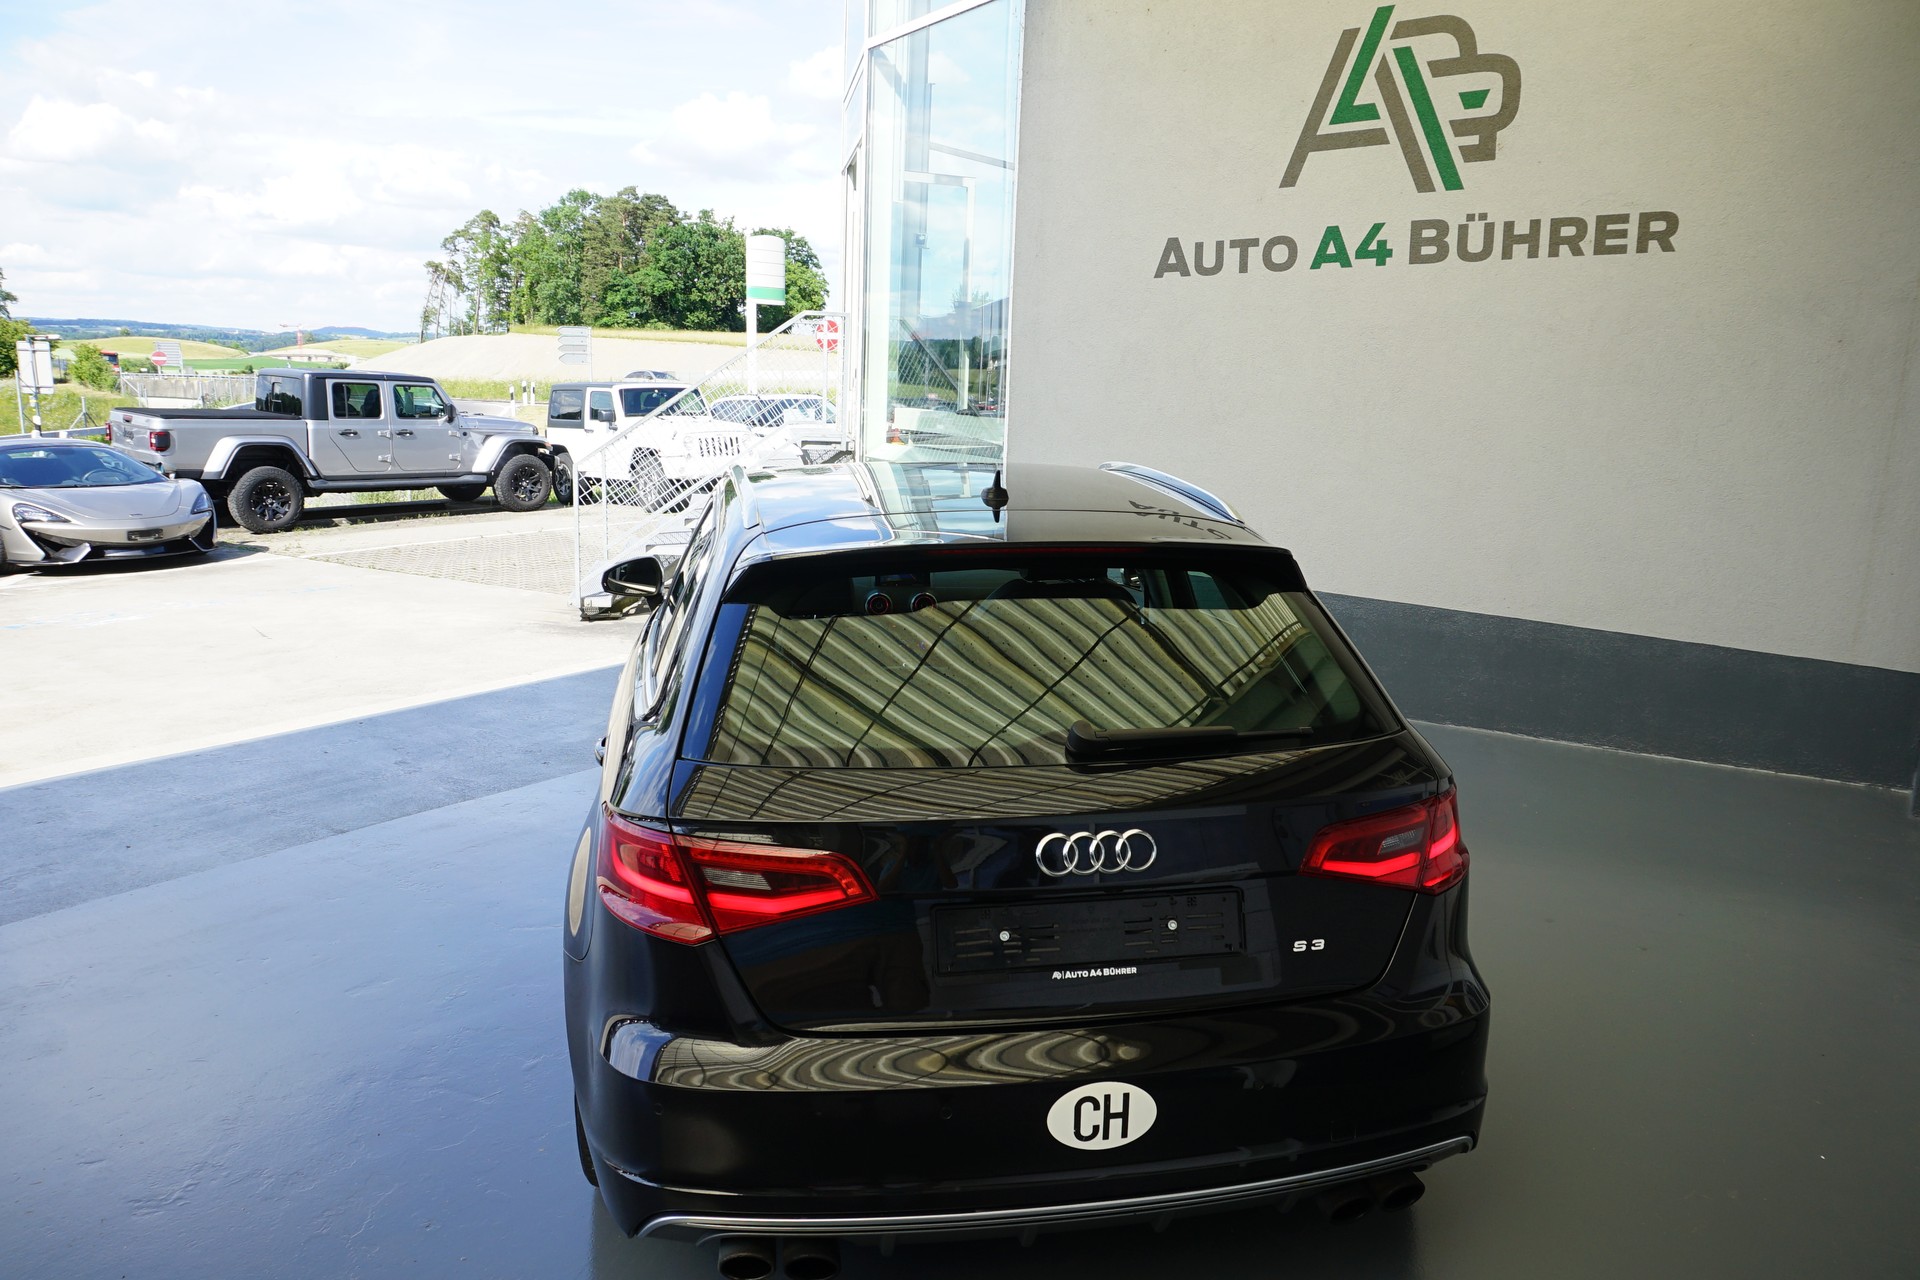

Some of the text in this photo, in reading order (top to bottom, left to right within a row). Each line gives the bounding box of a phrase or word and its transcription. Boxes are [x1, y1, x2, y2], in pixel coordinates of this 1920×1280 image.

[1153, 211, 1681, 279] AUTO A4 BÜHRER
[1064, 970, 1089, 979] AUTO
[1089, 968, 1103, 977] A4
[1073, 1092, 1131, 1143] CH
